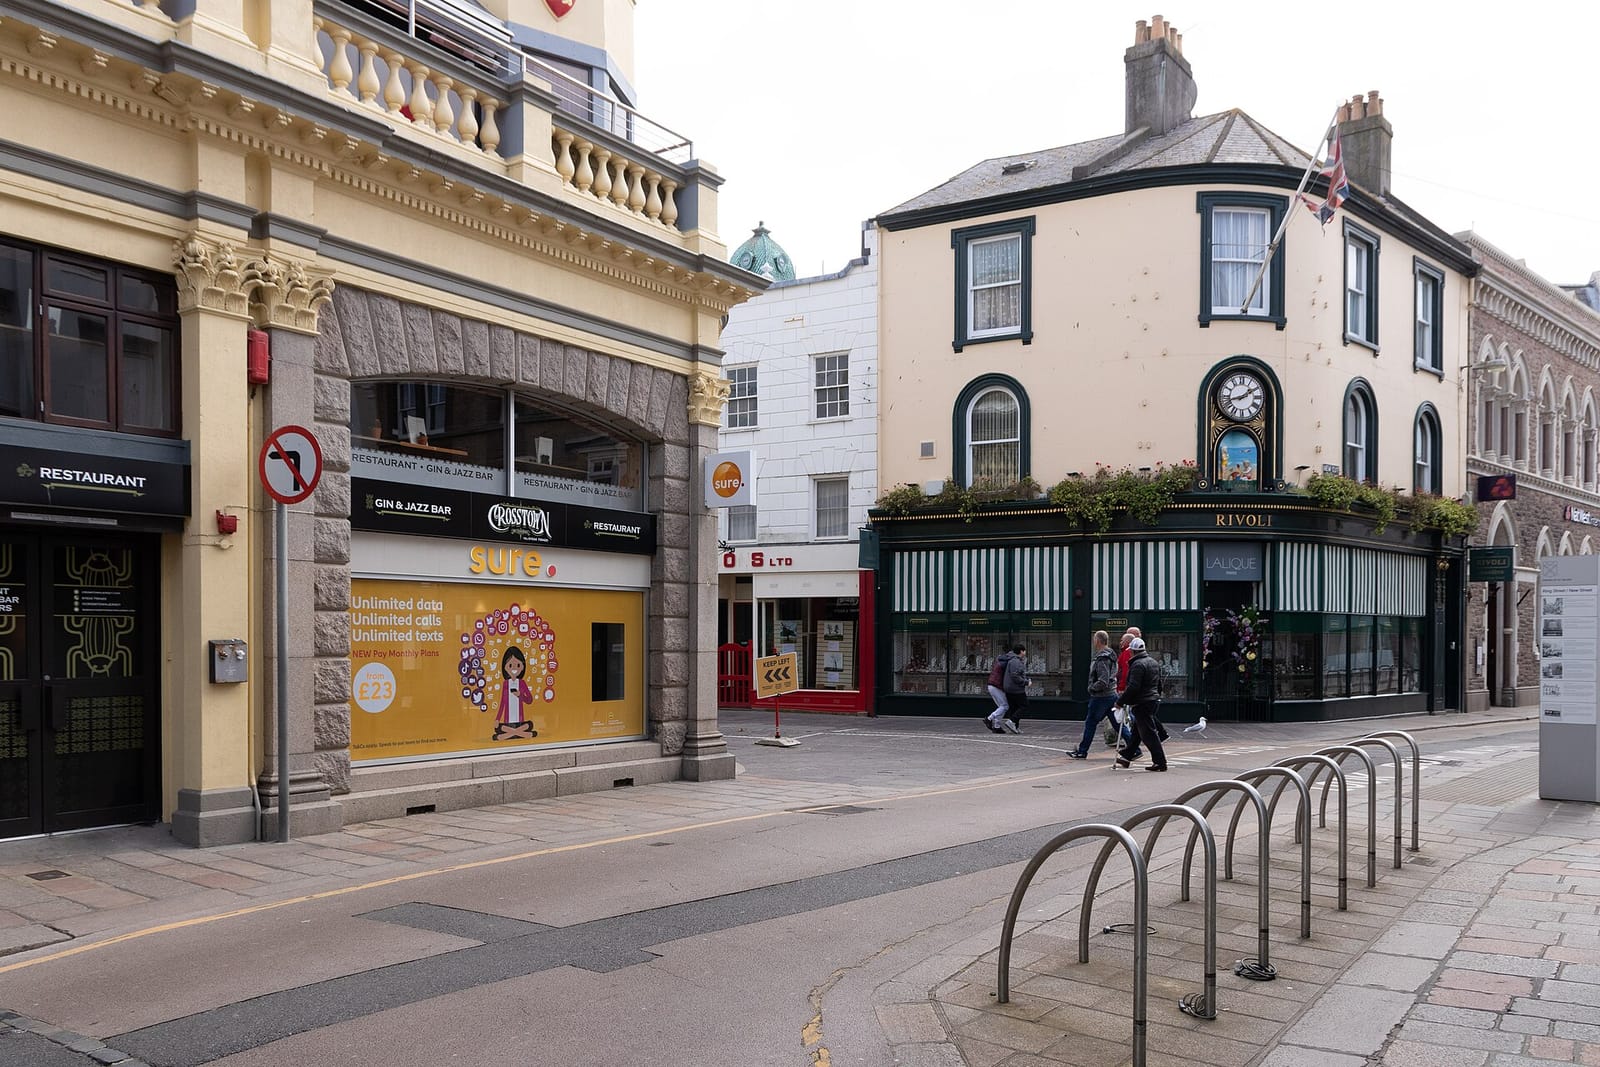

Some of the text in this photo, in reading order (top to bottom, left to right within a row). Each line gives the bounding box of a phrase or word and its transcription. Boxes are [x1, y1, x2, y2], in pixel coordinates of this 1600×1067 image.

[352, 453, 494, 481] RESTAURANT GIN & JAZZ BAR
[40, 466, 147, 488] RESTAURANT
[524, 478, 574, 492] RESTAURANT
[580, 485, 593, 495] GIN
[594, 487, 600, 495] &
[600, 488, 617, 497] JAZZ
[375, 498, 452, 515] GIN & JAZZ BAR
[488, 504, 552, 538] CROSSTOWN
[1215, 514, 1273, 527] RIVOLI
[593, 521, 641, 534] RESTAURANT
[769, 557, 793, 566] LTD
[1206, 557, 1257, 570] LALIQUE
[352, 596, 443, 611] Unlimited data
[352, 612, 442, 626] Unlimited calls
[352, 629, 444, 642] Unlimited texts
[352, 649, 440, 659] NEW Pay Monthly Plans
[778, 657, 790, 665] LEFT
[366, 672, 384, 680] from
[358, 680, 393, 701] £23
